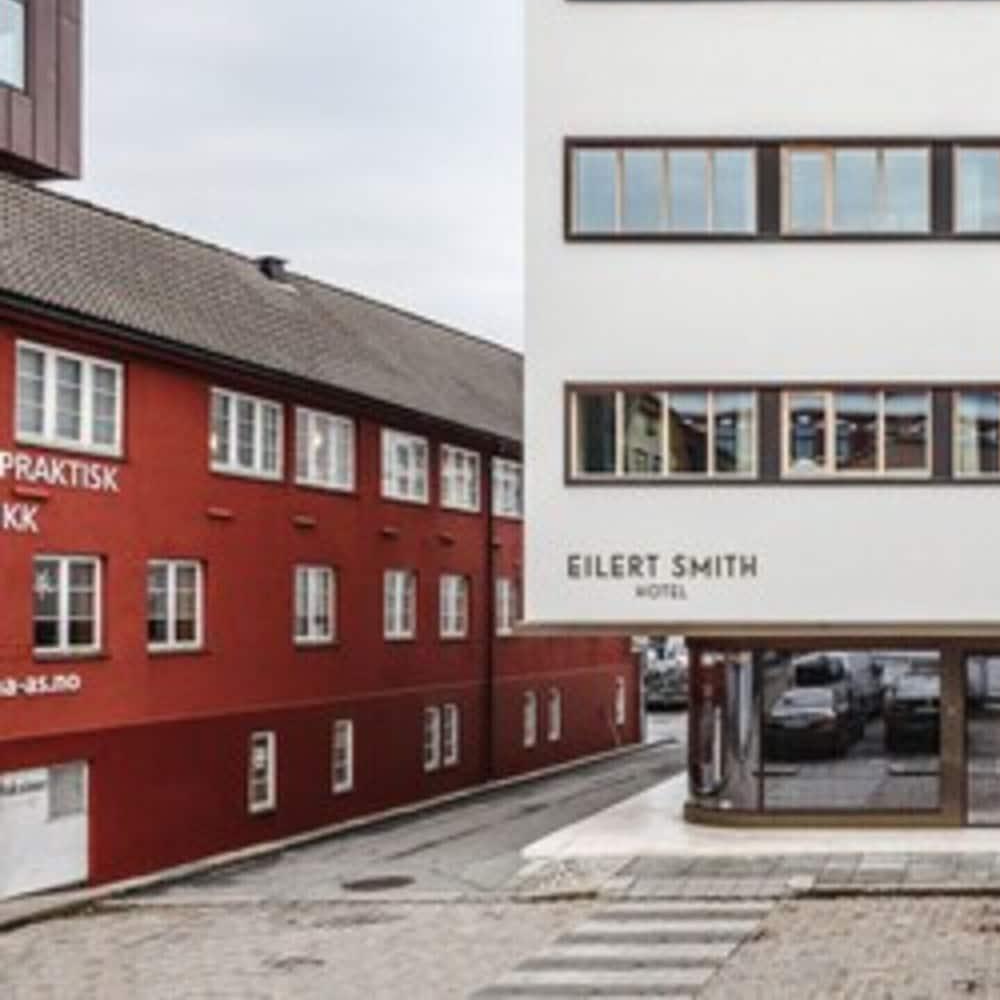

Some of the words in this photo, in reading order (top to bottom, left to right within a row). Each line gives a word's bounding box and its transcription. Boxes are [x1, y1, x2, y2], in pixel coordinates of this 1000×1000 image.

[0, 452, 119, 492] PRAKTISK
[567, 554, 658, 577] EILERT
[672, 554, 757, 577] SMITH
[635, 583, 687, 599] HOTEL
[0, 674, 81, 696] a-as.no
